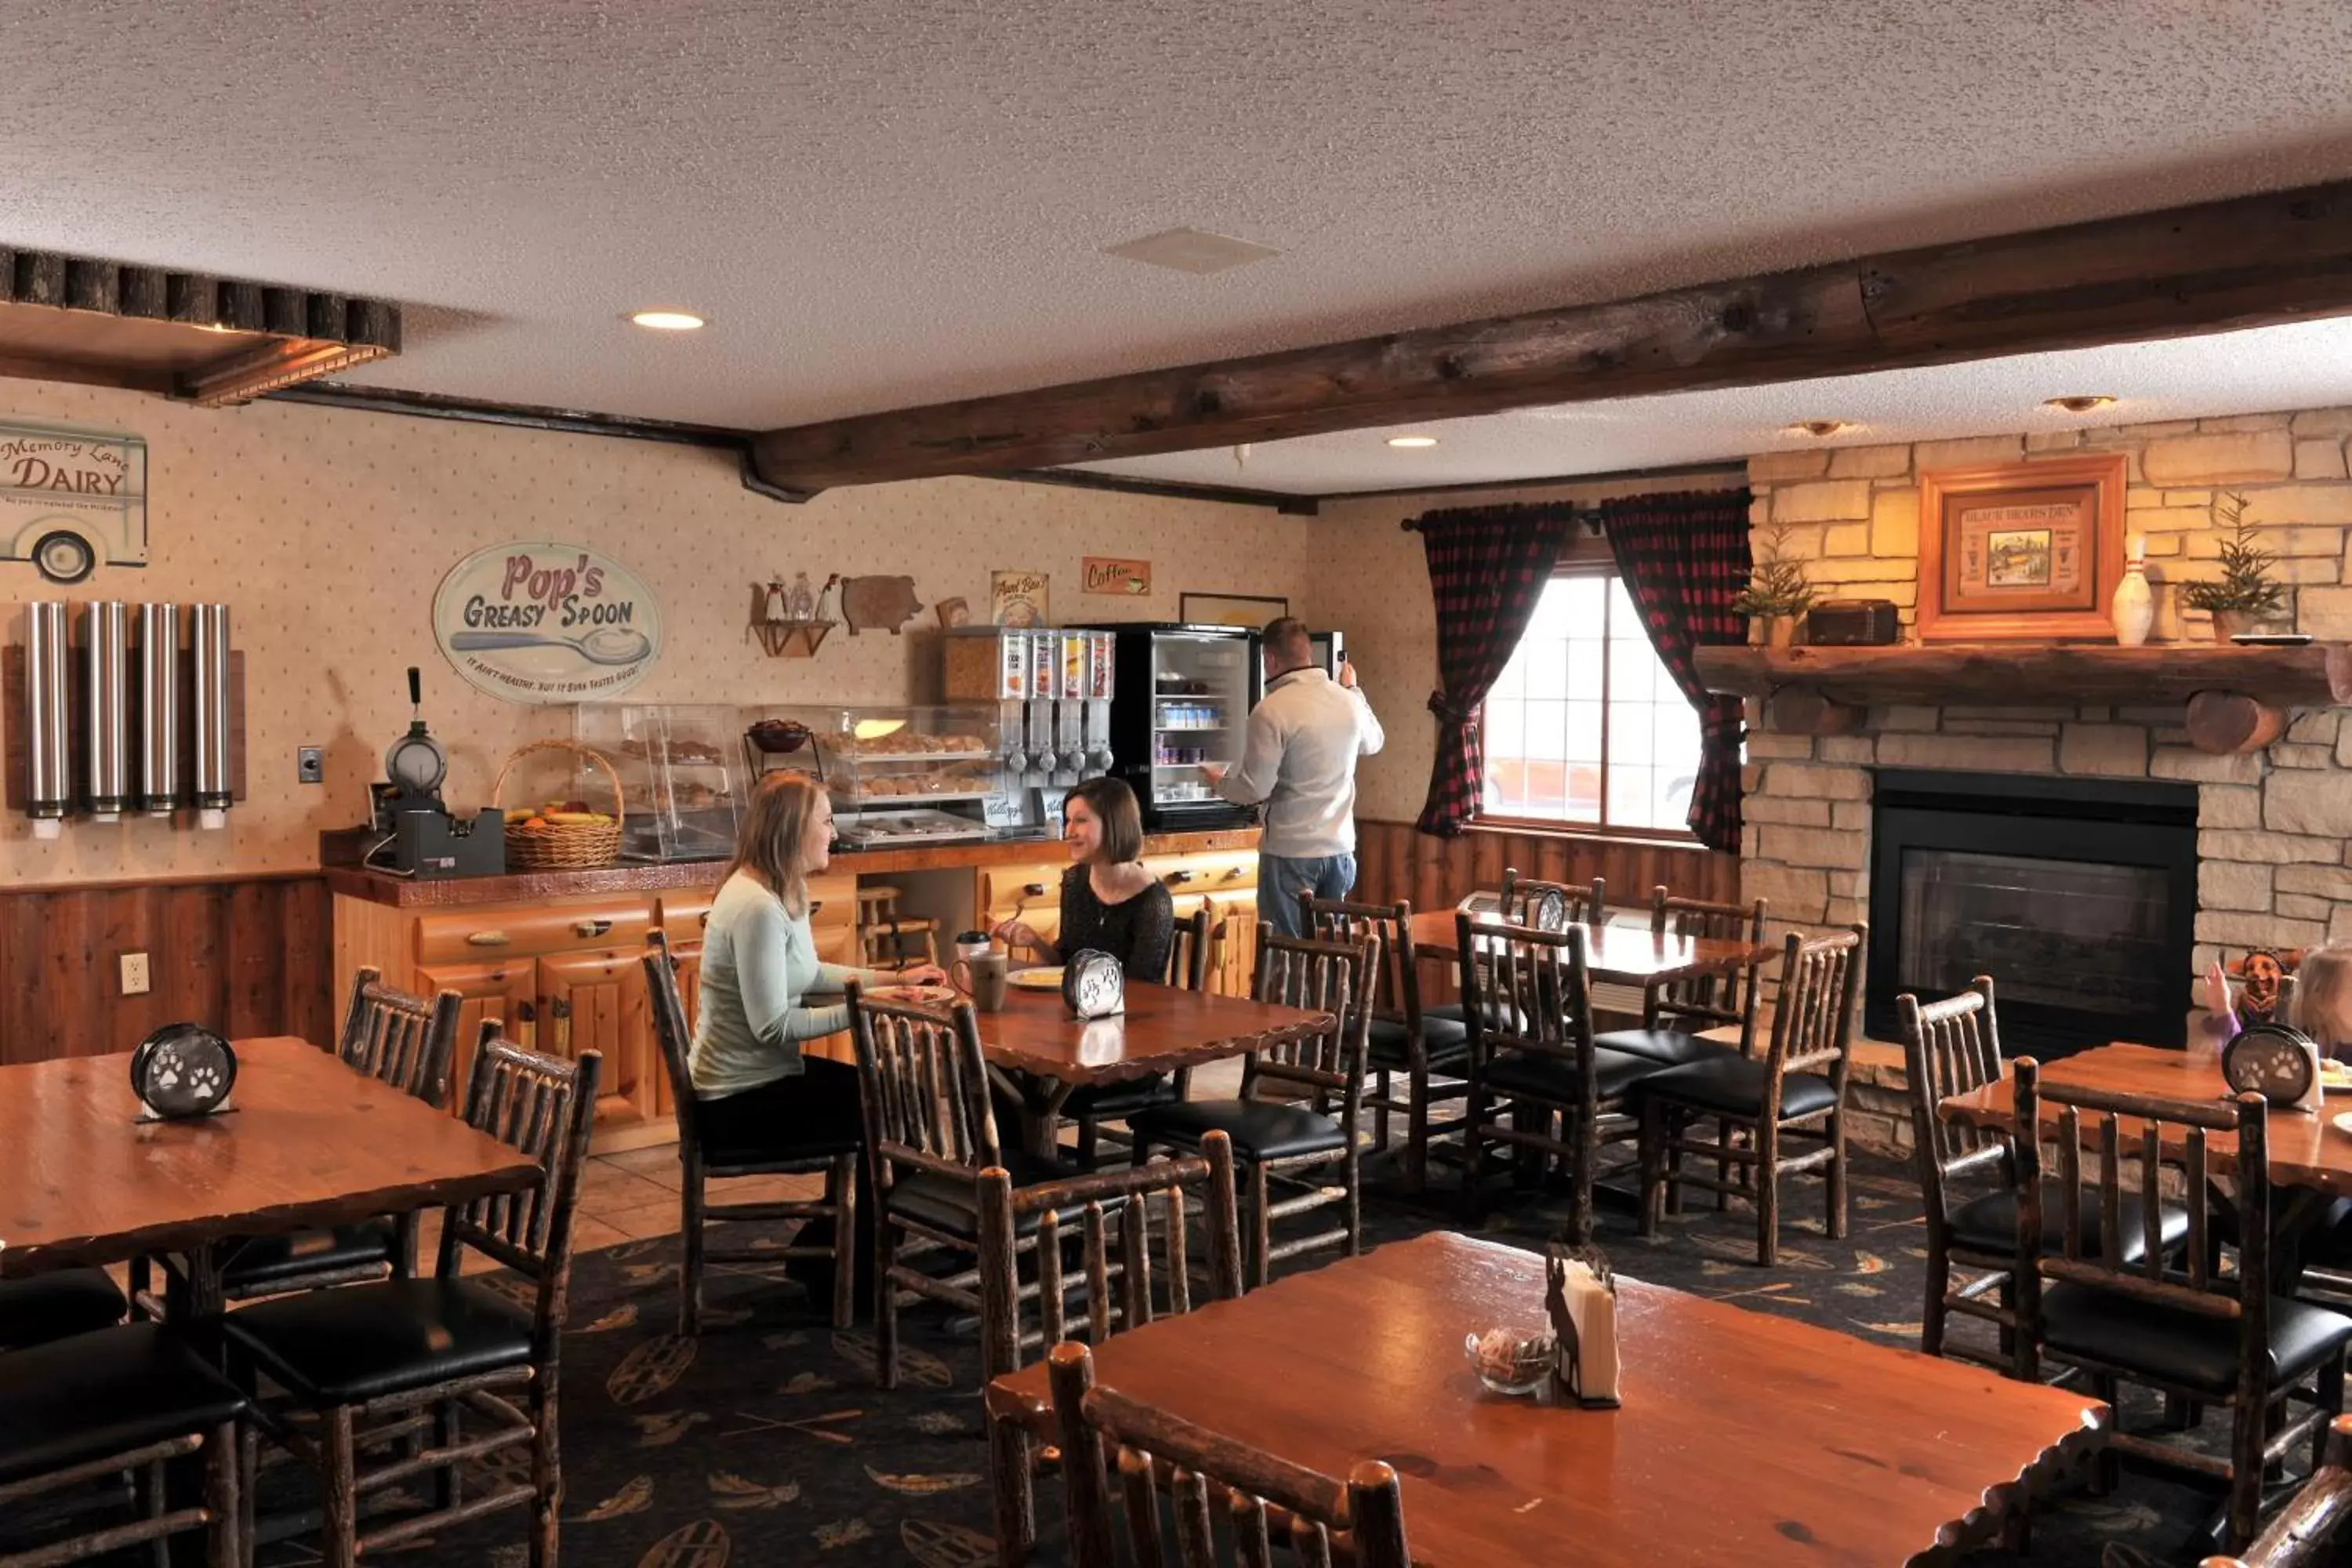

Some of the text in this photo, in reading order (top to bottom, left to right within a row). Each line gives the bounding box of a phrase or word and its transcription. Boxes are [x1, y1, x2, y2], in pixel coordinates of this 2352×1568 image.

[0, 439, 129, 472] Memory Lane
[12, 457, 122, 496] DAIRY
[502, 554, 604, 612] Pop's
[463, 593, 633, 629] GREASY SPOON
